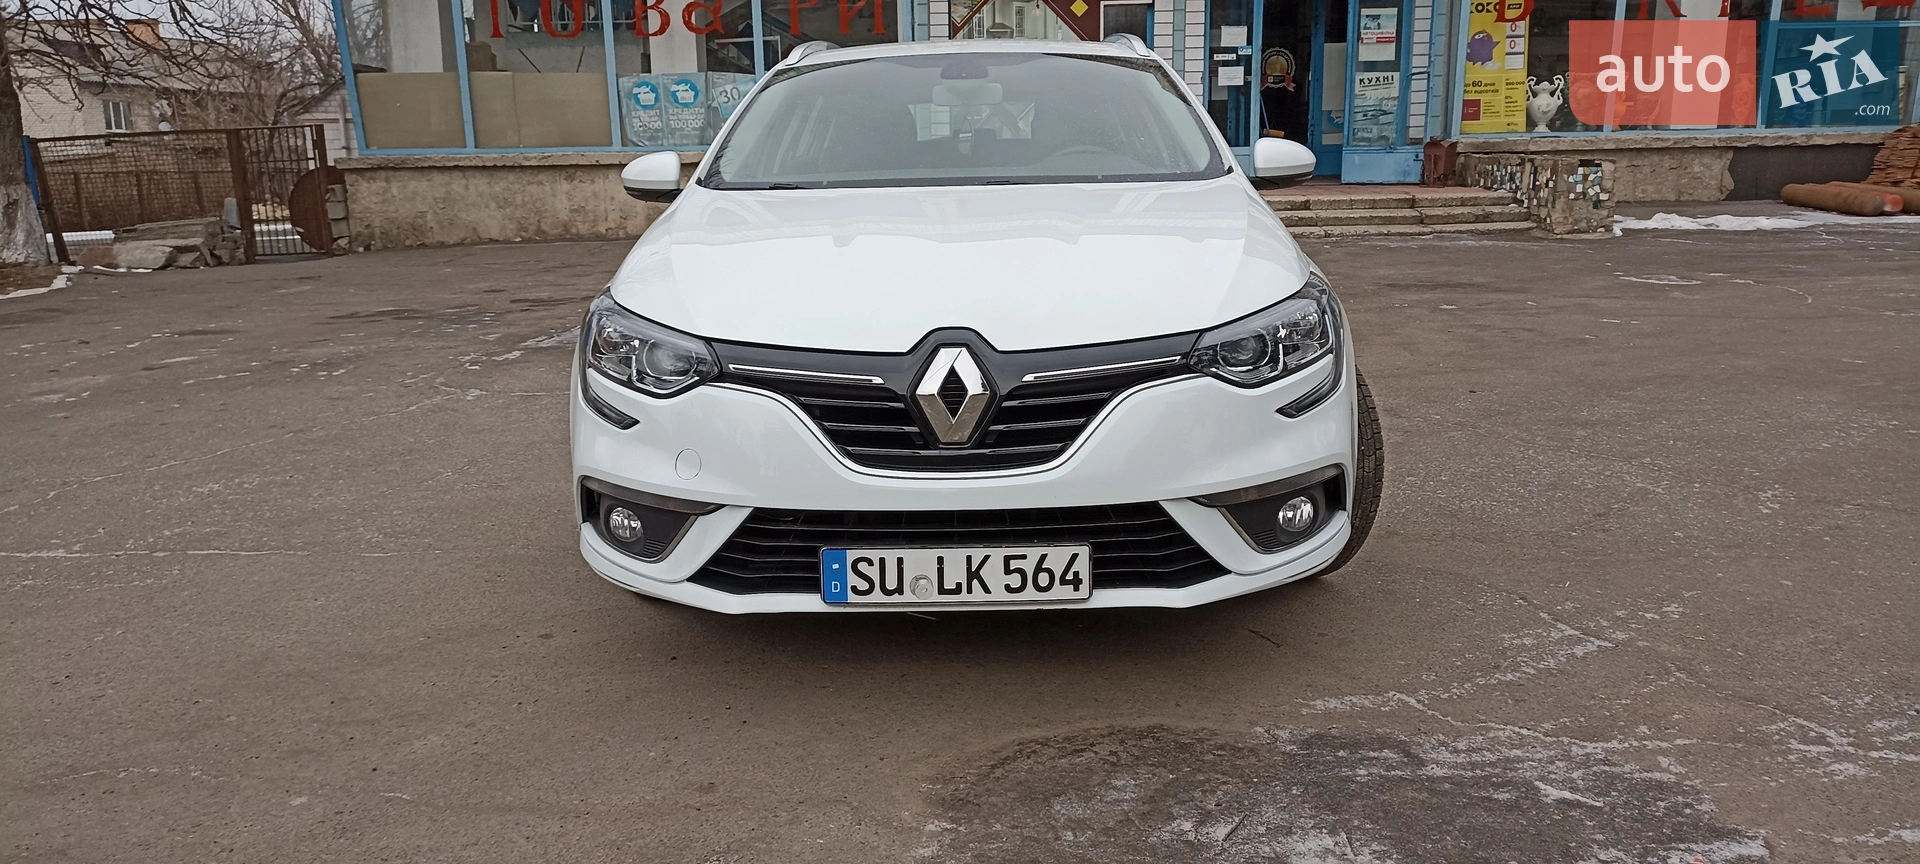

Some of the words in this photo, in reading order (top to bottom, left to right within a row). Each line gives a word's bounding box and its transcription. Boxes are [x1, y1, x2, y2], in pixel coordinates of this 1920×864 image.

[1359, 75, 1394, 85] КУХНІ
[1471, 80, 1483, 88] 60
[719, 86, 741, 104] 30
[850, 556, 904, 596] SU
[937, 555, 992, 595] LK
[1003, 552, 1083, 594] 564
[831, 581, 840, 593] D
